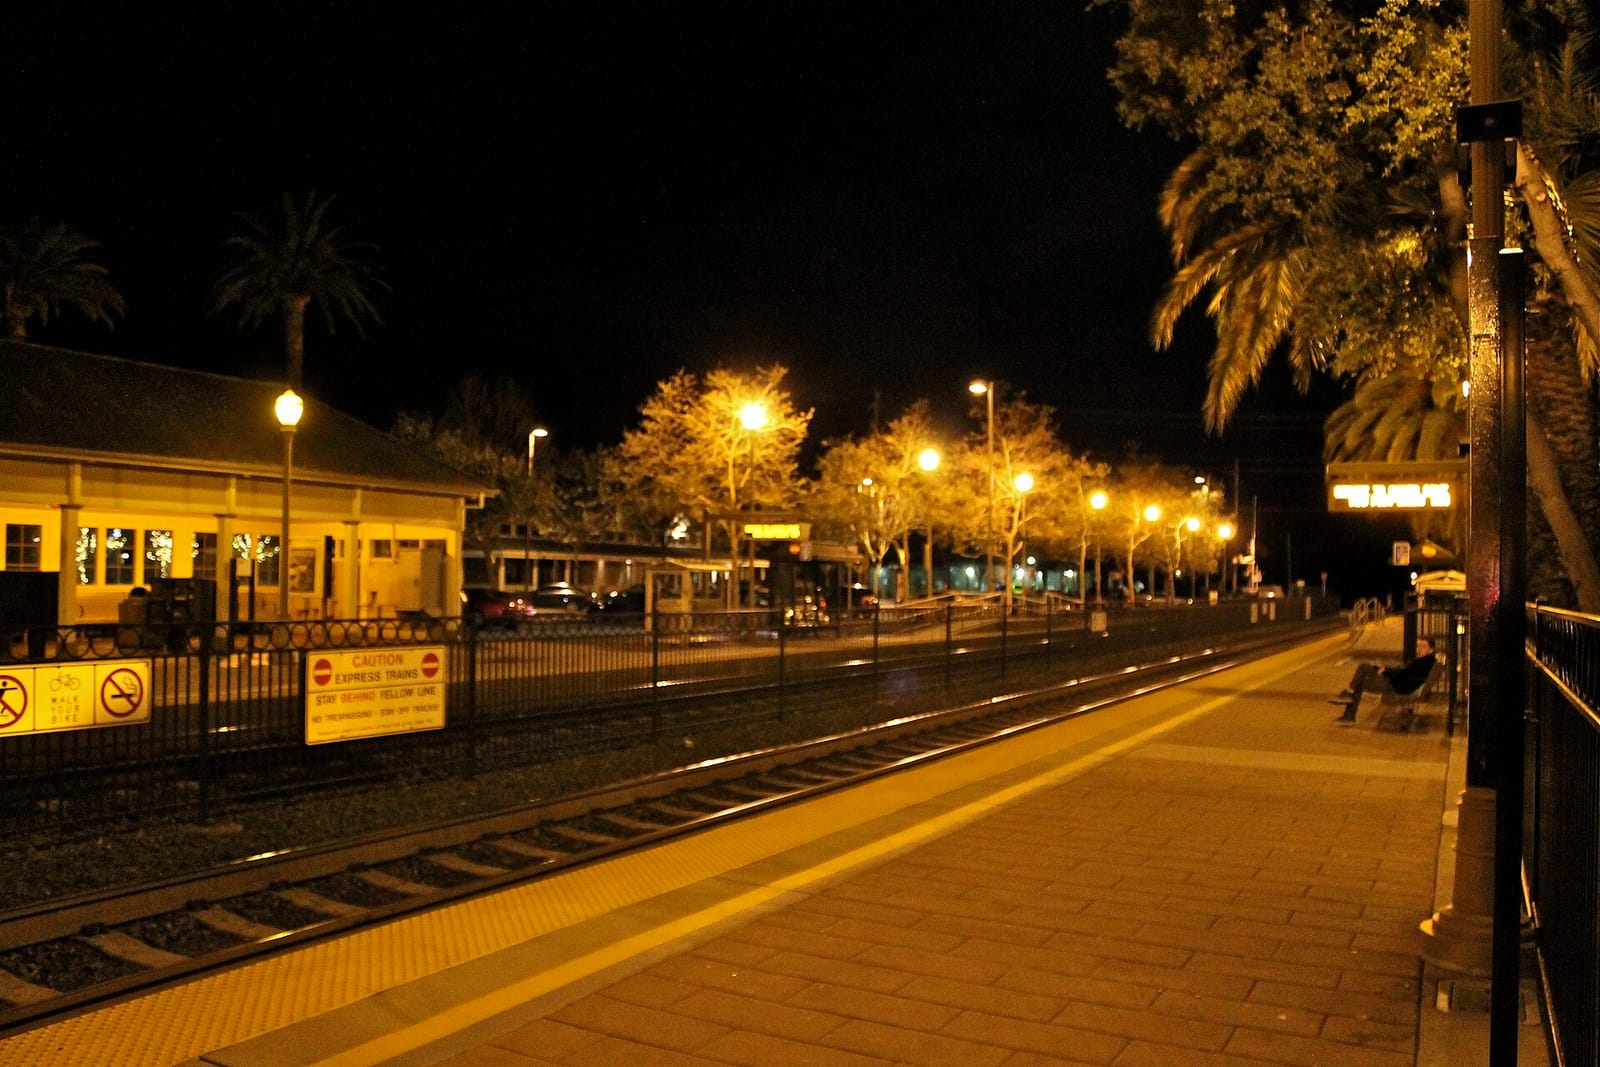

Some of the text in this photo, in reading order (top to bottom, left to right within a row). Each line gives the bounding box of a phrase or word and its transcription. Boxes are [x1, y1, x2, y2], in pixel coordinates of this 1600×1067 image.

[352, 653, 404, 668] CAUTION
[335, 668, 418, 685] EXPRESS TRAINS
[316, 686, 437, 706] STAY BEHIND YELLOW LINE
